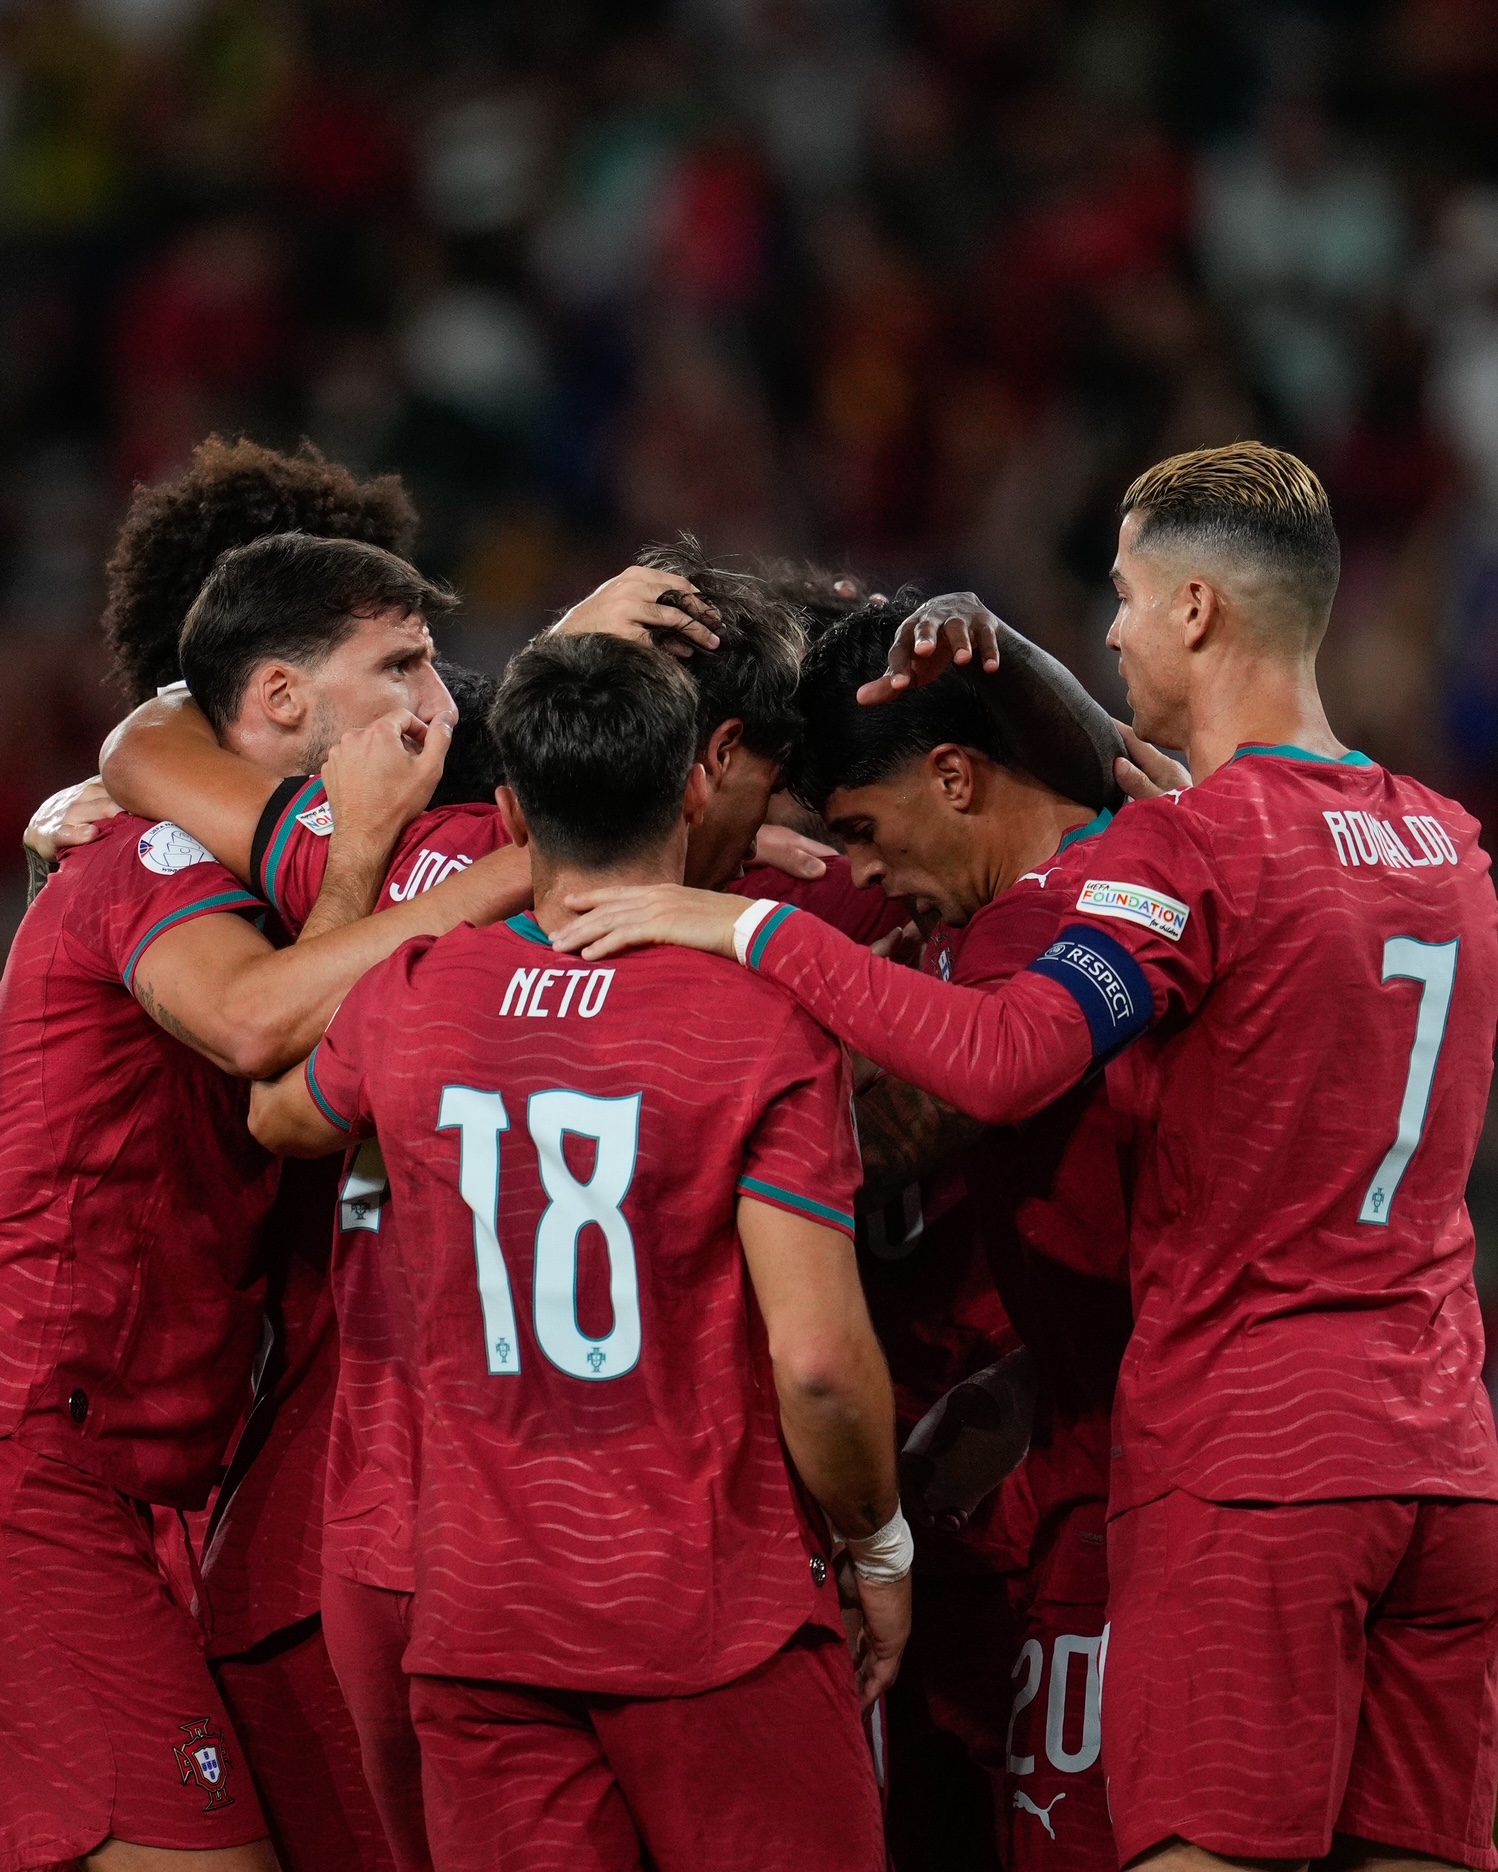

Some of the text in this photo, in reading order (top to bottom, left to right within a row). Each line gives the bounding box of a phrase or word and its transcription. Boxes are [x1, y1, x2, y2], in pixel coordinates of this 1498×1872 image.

[1322, 810, 1458, 869] RONALDO
[1083, 889, 1185, 929] FOUNDATION
[1086, 882, 1110, 891] UEFA
[1149, 918, 1179, 938] for children
[498, 967, 617, 1019] NETO
[1066, 947, 1130, 1020] RESPECT
[1356, 934, 1461, 1226] 7
[435, 1085, 643, 1382] 18
[1006, 1634, 1102, 1776] 20
